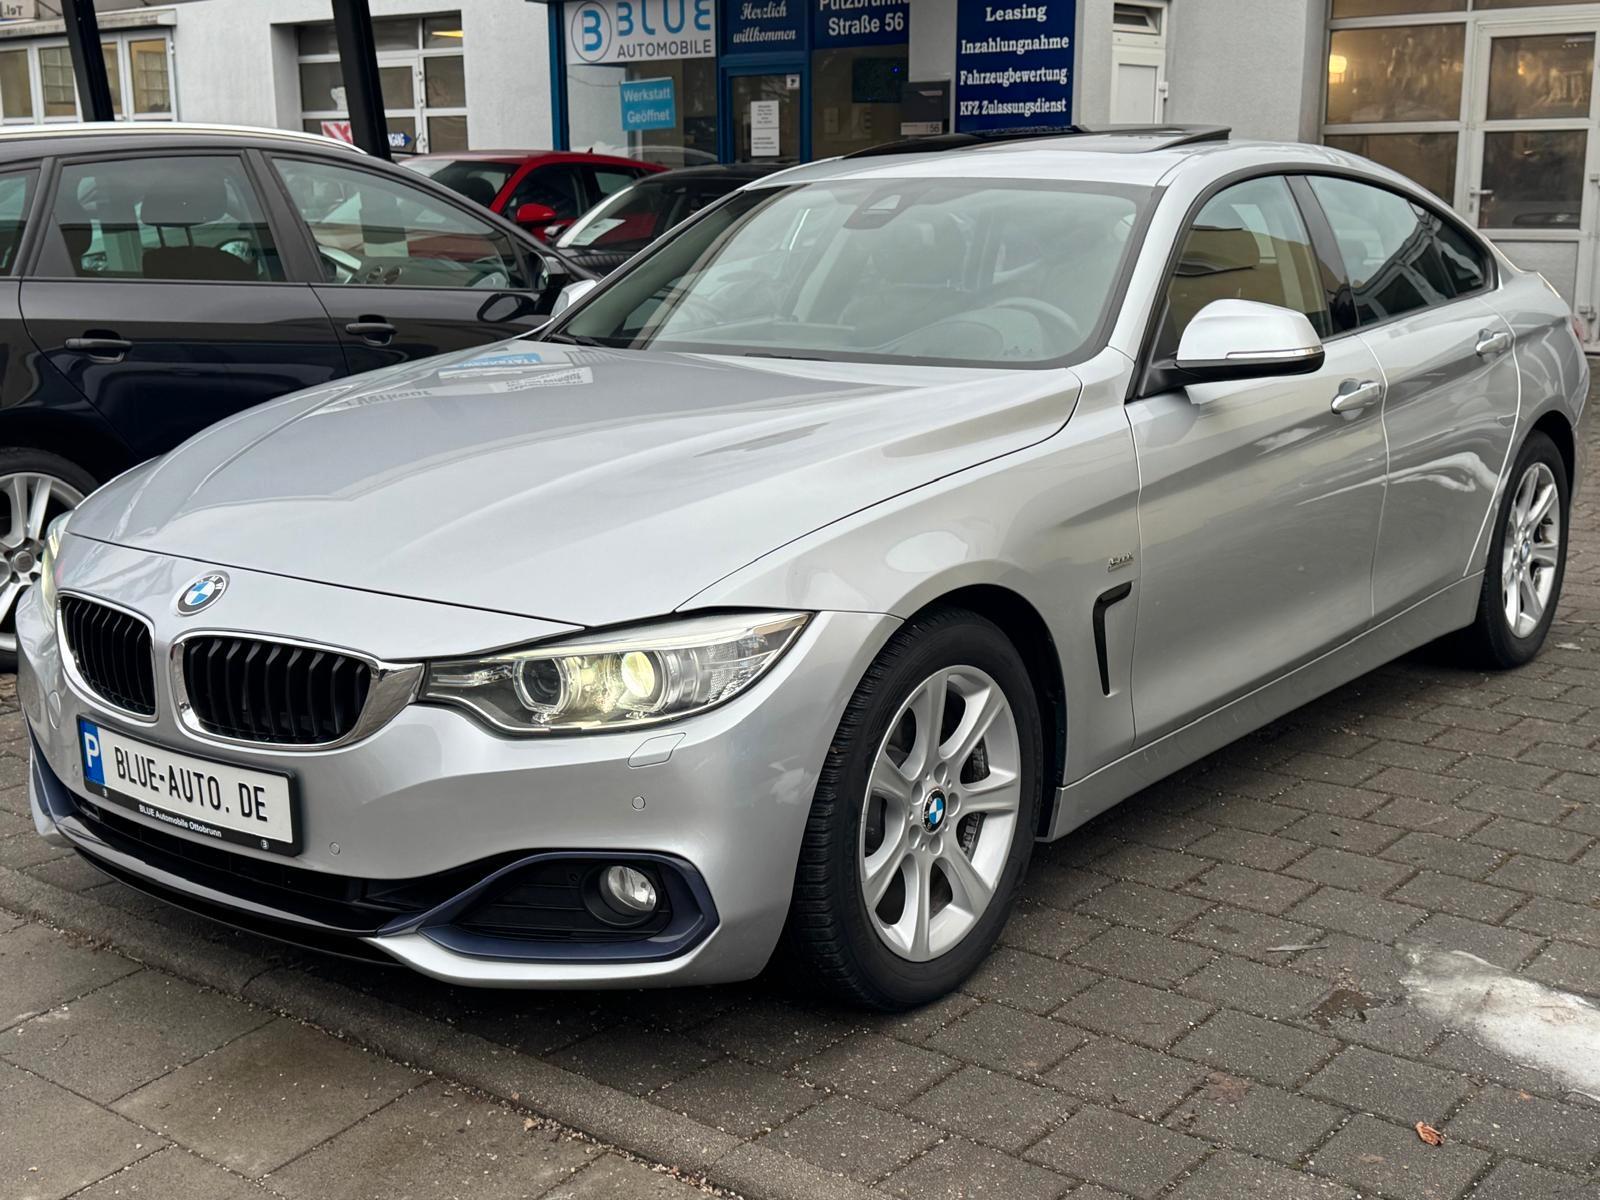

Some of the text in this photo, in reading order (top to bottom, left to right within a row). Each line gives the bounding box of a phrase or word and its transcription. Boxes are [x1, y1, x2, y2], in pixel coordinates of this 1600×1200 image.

[617, 0, 711, 37] BLUE
[741, 0, 787, 20] Herzlich
[985, 4, 1047, 22] Leasing
[828, 12, 904, 36] Straße 56
[733, 26, 796, 43] willkommen
[961, 34, 1069, 55] Inzahlungnahme
[617, 39, 712, 59] AUTOMOBILE
[960, 66, 1067, 87] Fahrzeugbewertung
[623, 87, 671, 102] Werkstatt
[627, 109, 670, 124] Geöffnet
[960, 97, 1066, 117] KFZ Zulassungsdienst
[84, 732, 99, 768] P
[138, 803, 222, 838] BLUE Automobile Ottobrunn
